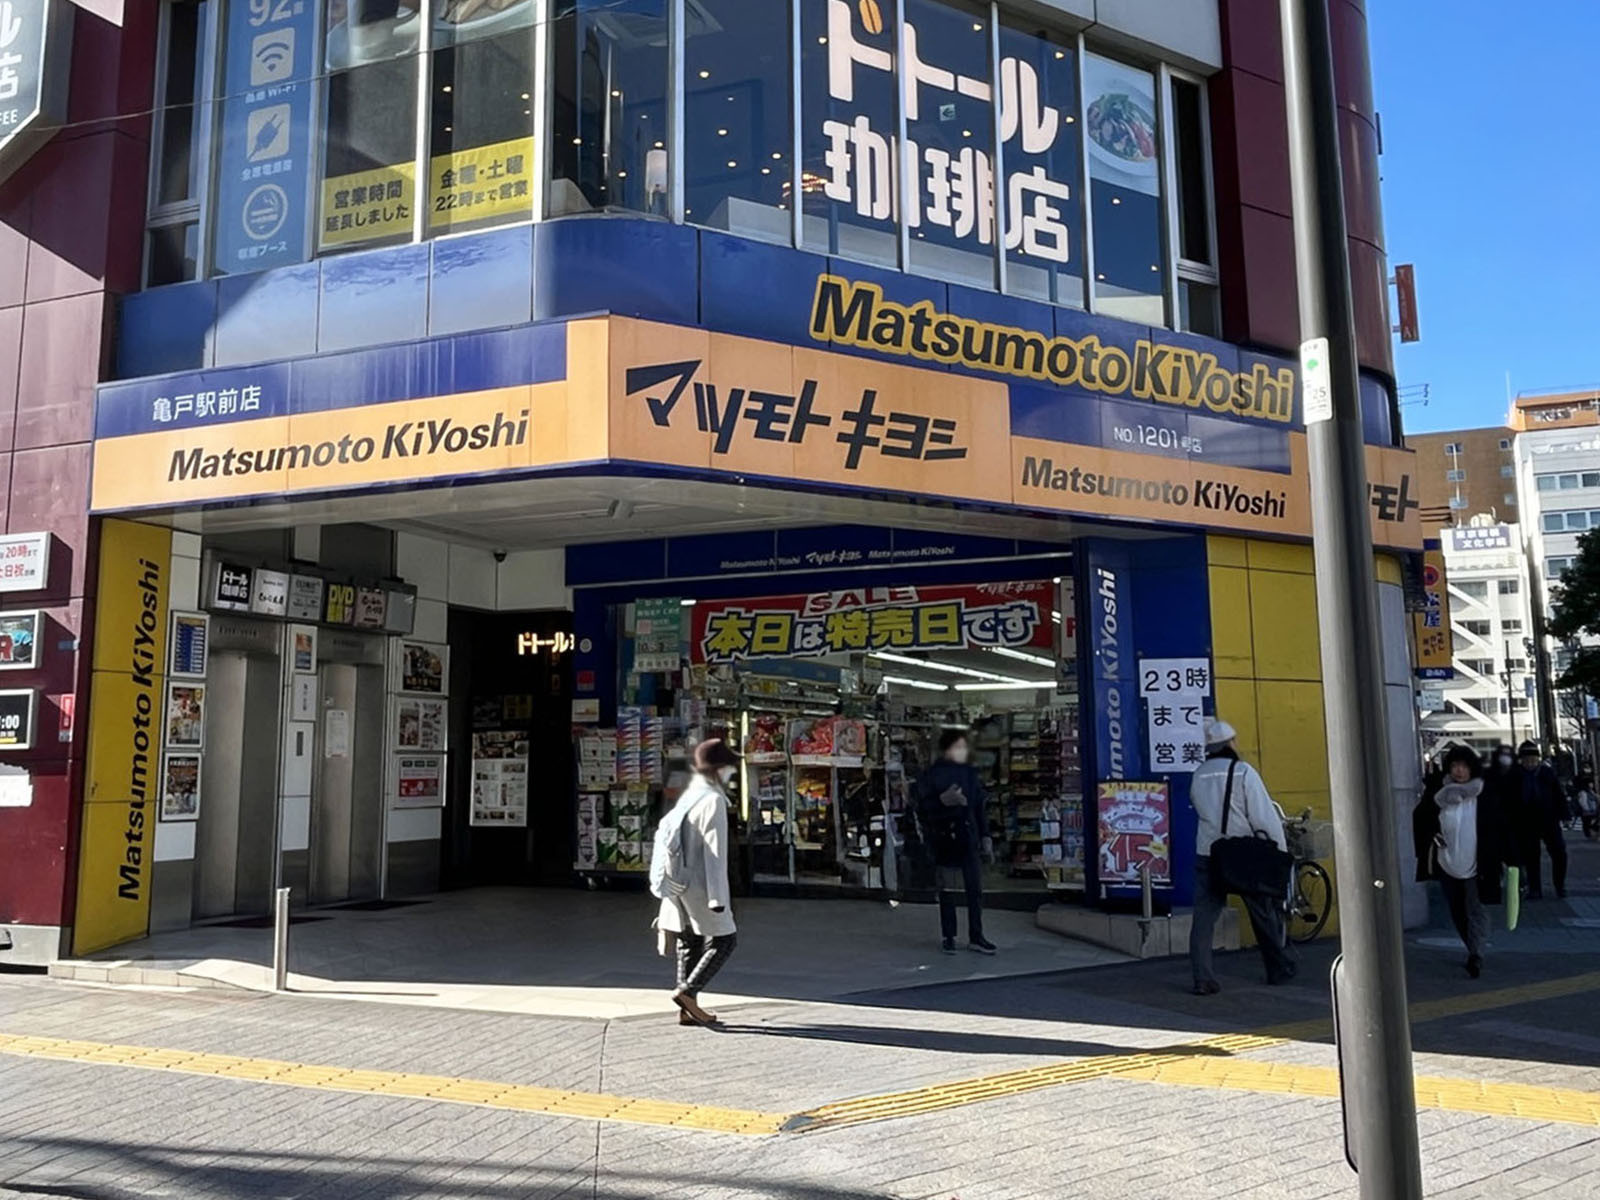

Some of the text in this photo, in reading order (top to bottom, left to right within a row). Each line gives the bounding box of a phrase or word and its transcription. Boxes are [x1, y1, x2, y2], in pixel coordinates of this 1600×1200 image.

[828, 0, 1059, 153] ドトール
[0, 109, 18, 125] EE
[440, 154, 524, 190] 金曜・土曜
[823, 115, 1070, 263] 珈琲店
[334, 179, 404, 209] 営業時間
[435, 179, 528, 212] 22時まで営業
[325, 203, 409, 232] 延長しました
[152, 384, 261, 423] 亀戸駅前店
[168, 408, 530, 482] Matsumoto KiYoshi
[1021, 456, 1287, 519] Matsumoto KiYoshi
[1368, 475, 1419, 522] モト
[330, 584, 354, 606] DVD
[808, 587, 915, 613] SALE
[705, 602, 1036, 658] 本日は特売日です
[1098, 568, 1120, 683] KiYoshi
[1144, 667, 1208, 692] 23時
[0, 715, 19, 729] :00
[118, 558, 160, 900] Matsumoto KiYoshi
[1153, 705, 1201, 727] まで
[1154, 743, 1206, 765] 営業
